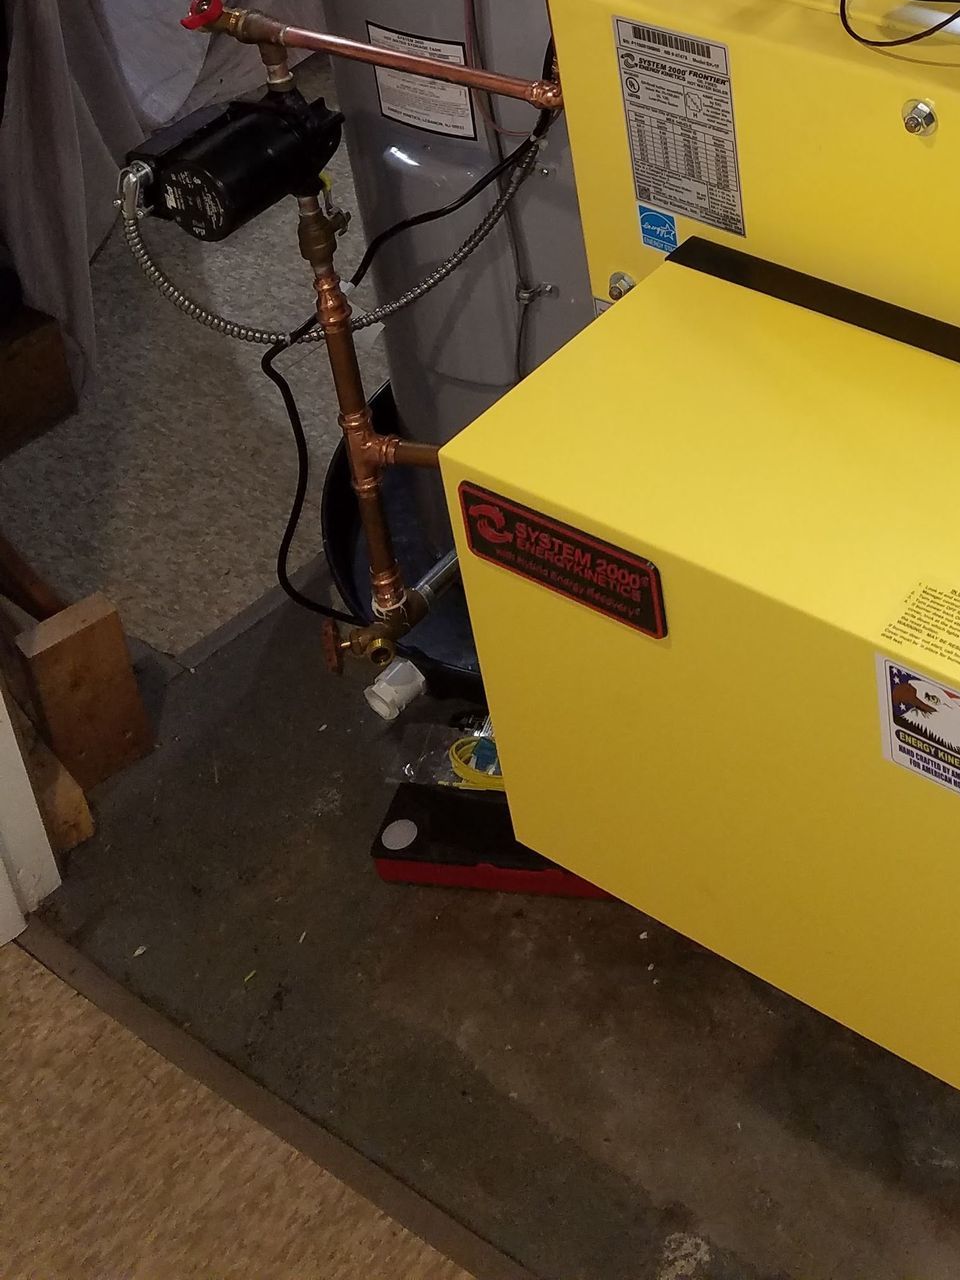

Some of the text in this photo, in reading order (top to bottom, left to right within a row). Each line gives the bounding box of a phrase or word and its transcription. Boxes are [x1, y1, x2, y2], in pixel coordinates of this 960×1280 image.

[638, 57, 667, 70] SYSTEM
[516, 522, 591, 567] SYSTEM
[549, 571, 584, 594] Energy
[899, 731, 937, 755] ENERGY
[898, 744, 915, 758] HAND
[915, 751, 942, 770] CRAFTED
[942, 762, 951, 774] BY
[909, 758, 921, 770] FOR
[922, 763, 953, 785] AMERICAN
